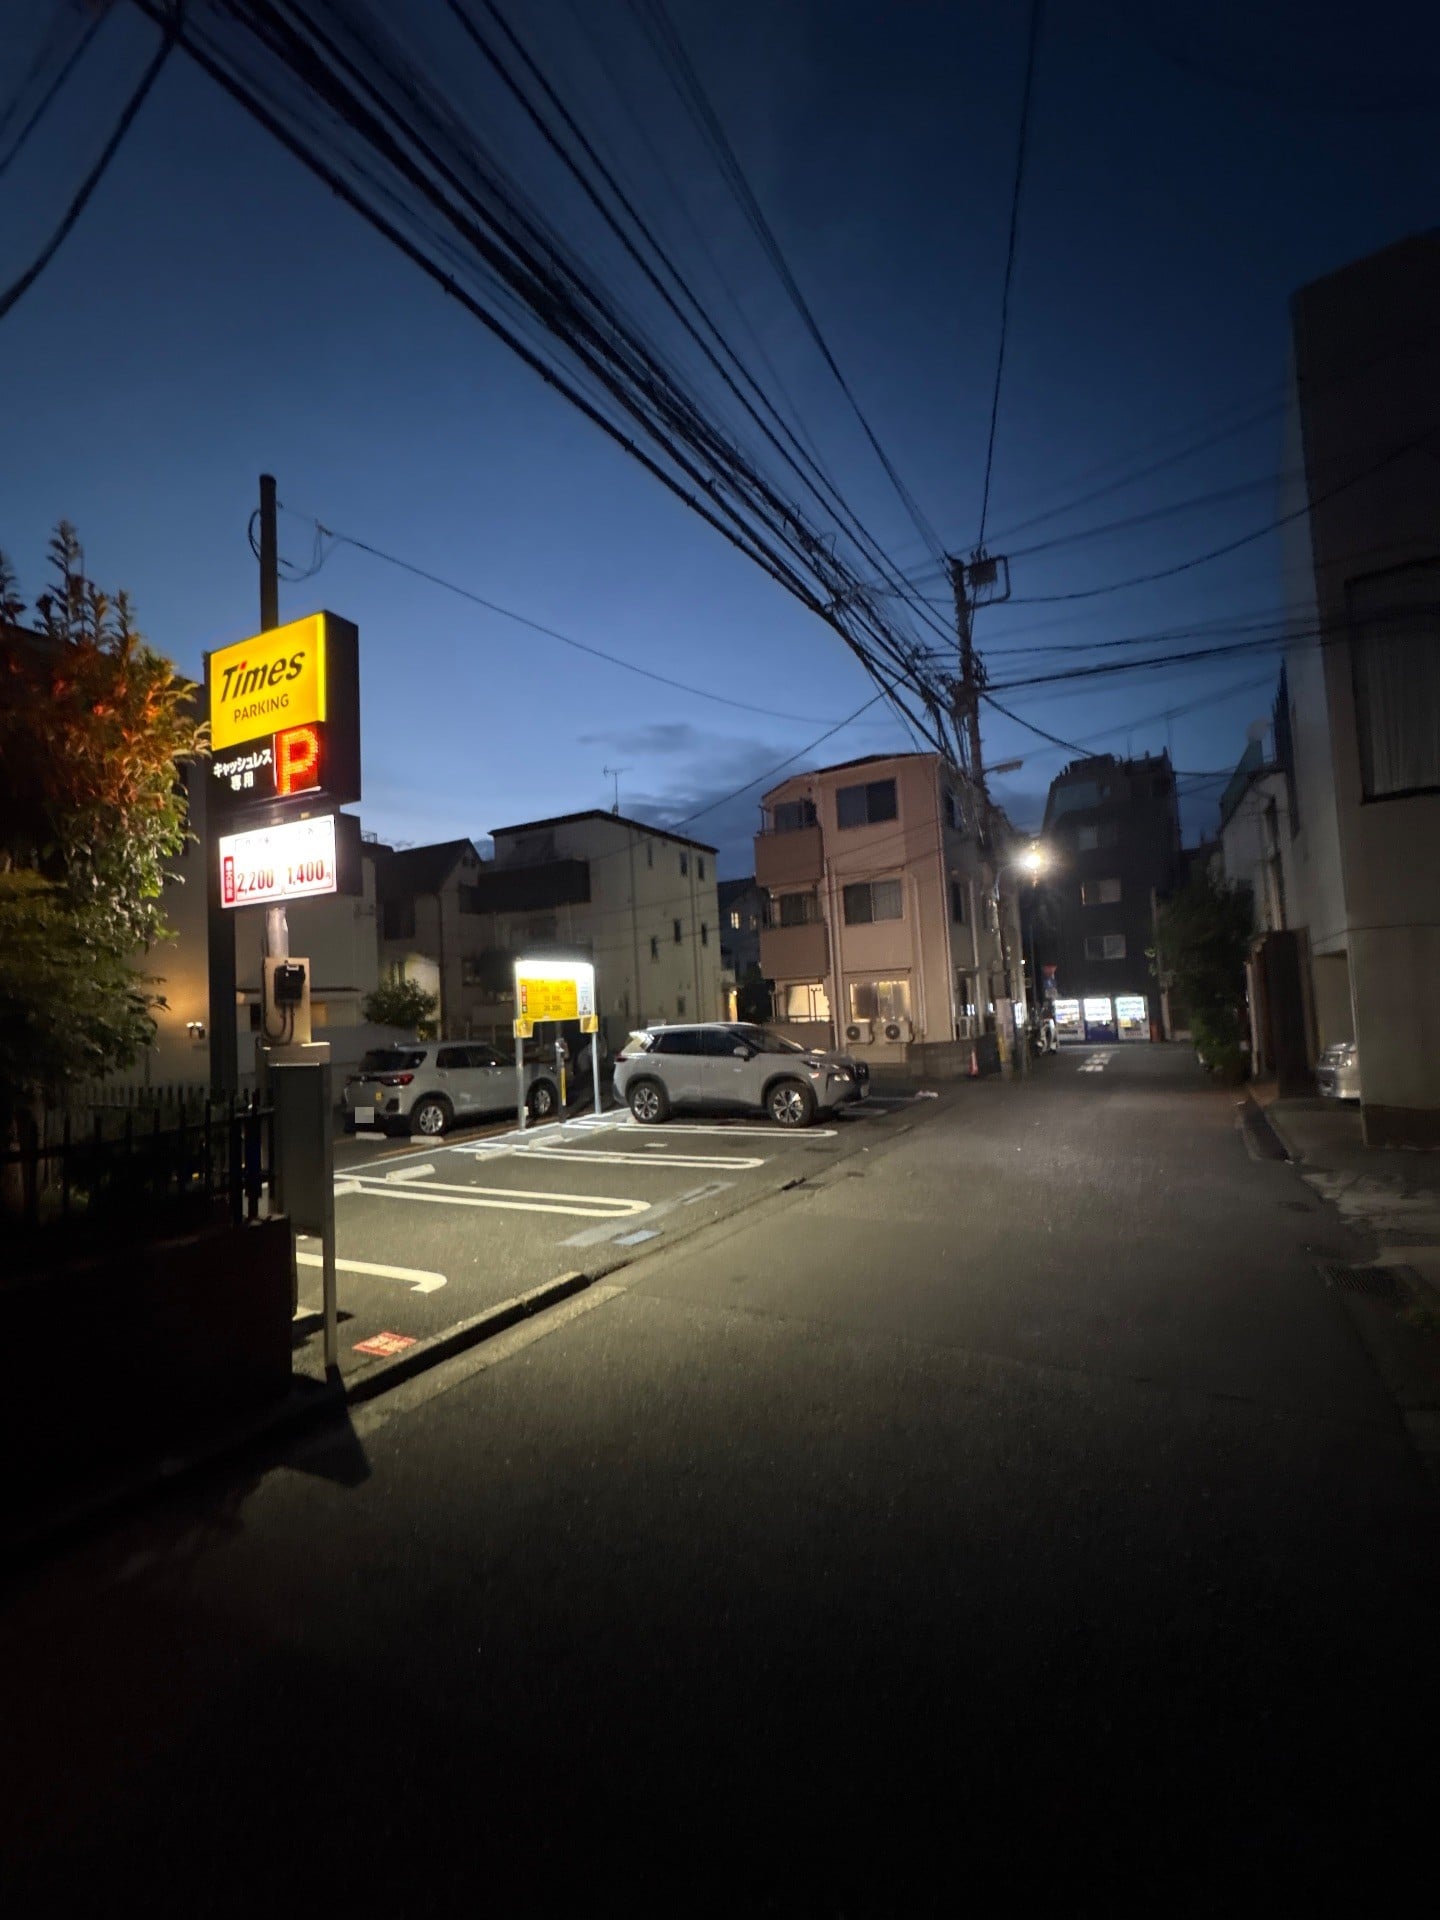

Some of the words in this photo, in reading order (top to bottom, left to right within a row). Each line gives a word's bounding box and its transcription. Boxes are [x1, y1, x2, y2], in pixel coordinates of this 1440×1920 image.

[221, 651, 305, 703] Times
[234, 693, 289, 723] PARKING
[213, 748, 272, 778] キャッシュレス
[230, 771, 254, 791] 専用
